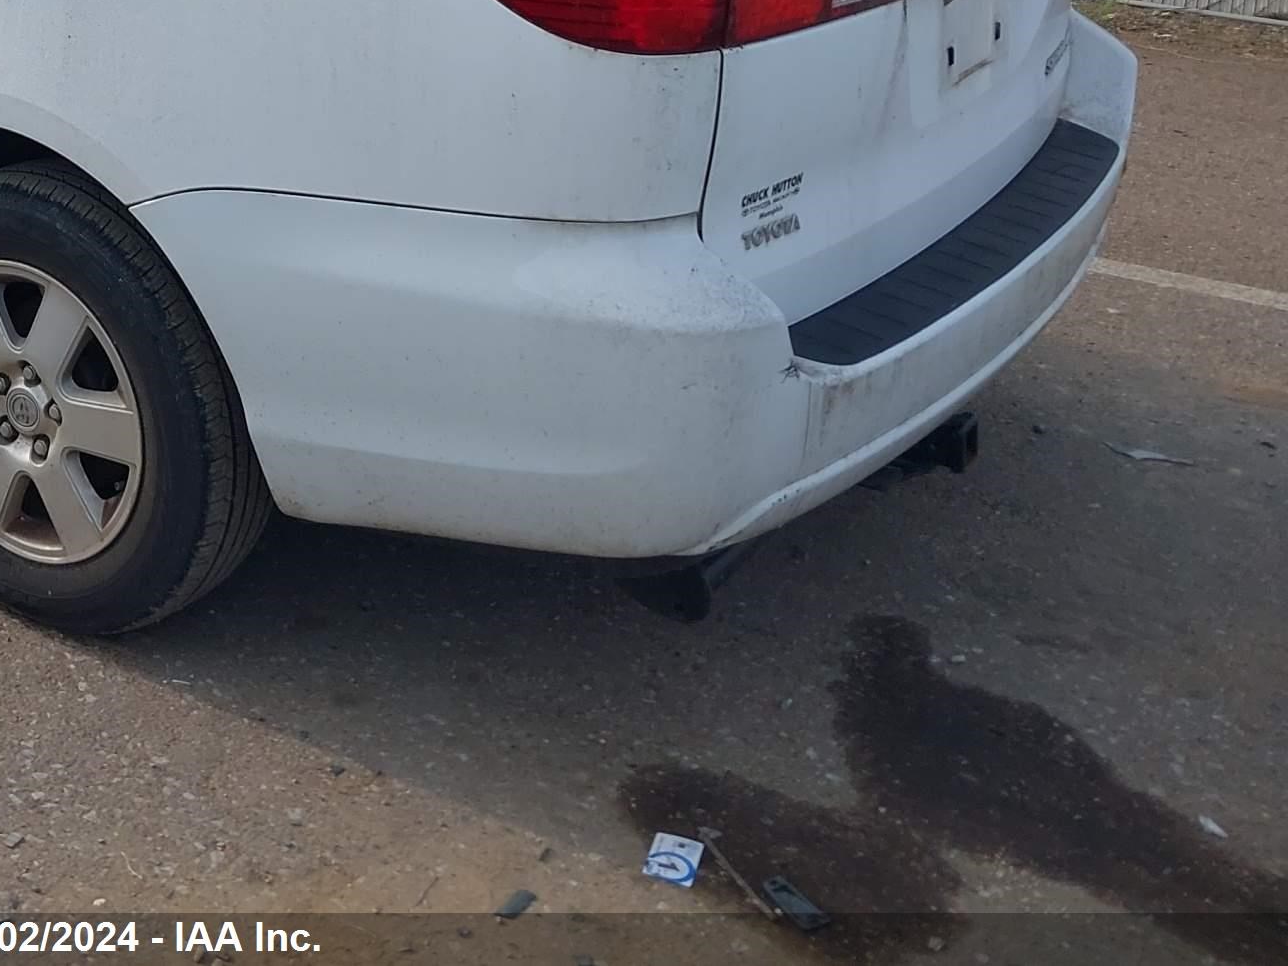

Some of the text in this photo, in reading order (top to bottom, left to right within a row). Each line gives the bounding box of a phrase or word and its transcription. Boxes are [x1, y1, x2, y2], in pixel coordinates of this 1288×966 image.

[741, 186, 770, 208] CHUCK
[771, 172, 803, 195] HUTTON
[741, 214, 800, 250] TOYOTA
